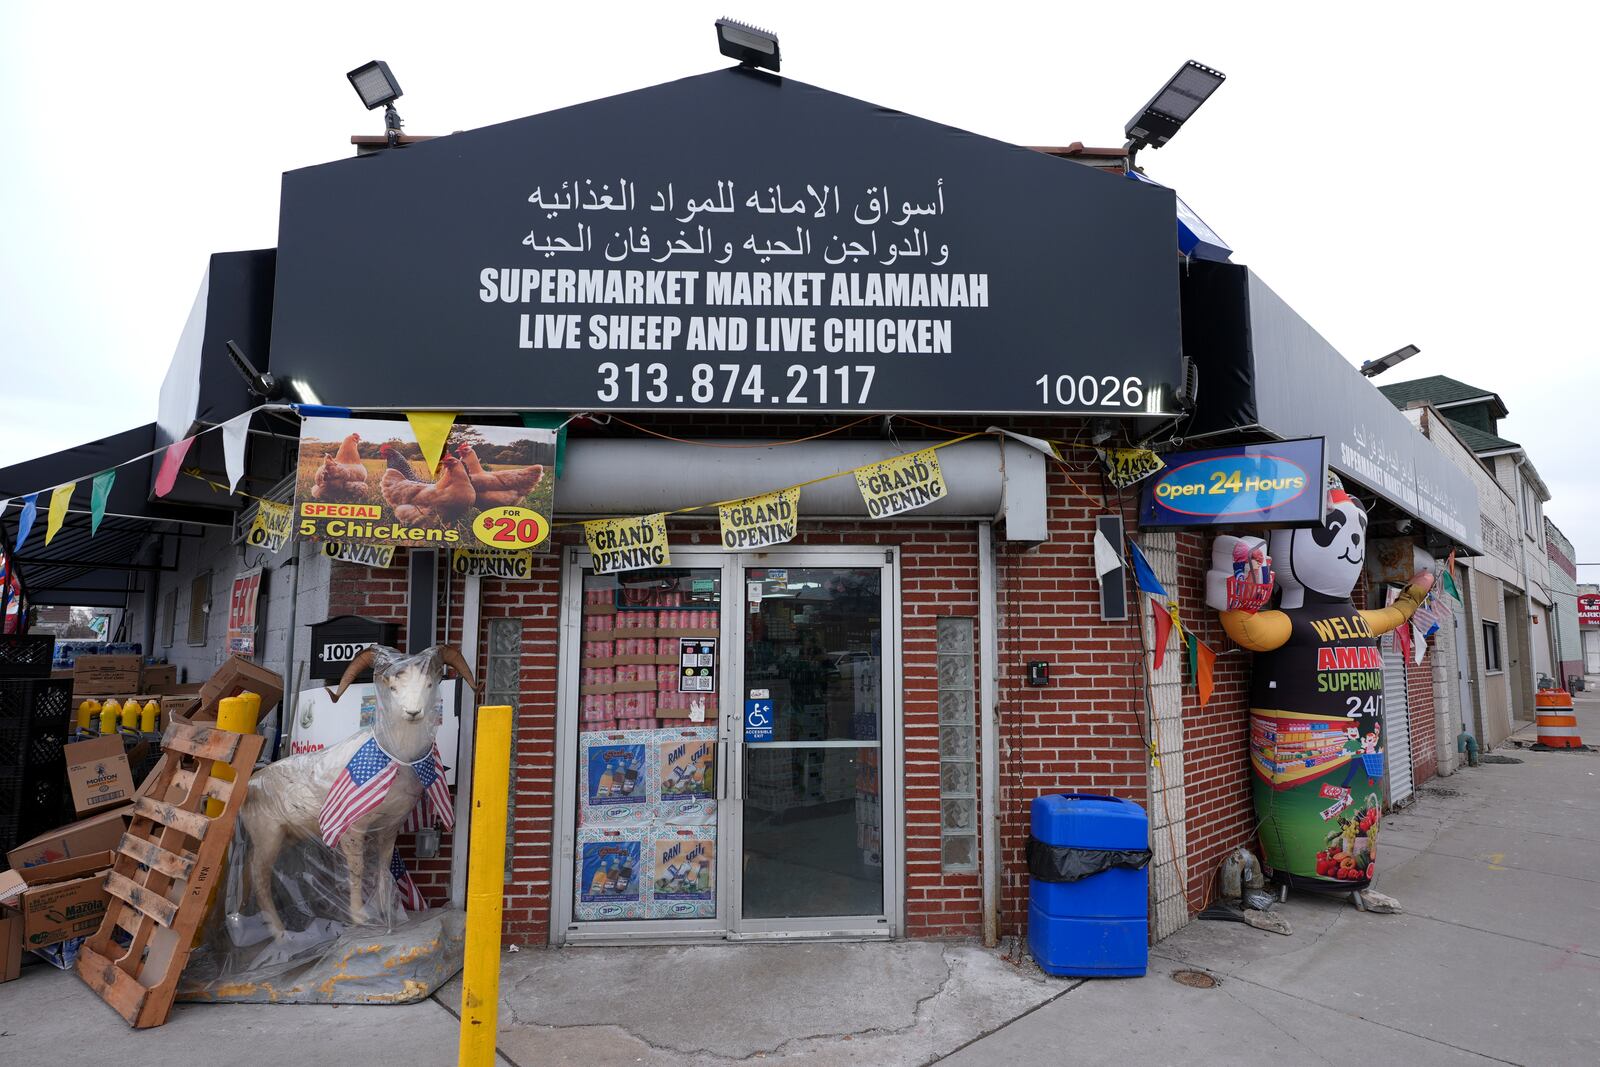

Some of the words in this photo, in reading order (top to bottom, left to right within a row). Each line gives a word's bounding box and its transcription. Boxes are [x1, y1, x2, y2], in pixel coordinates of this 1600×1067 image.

[528, 178, 635, 220] الغذائيه
[651, 179, 735, 223] للمواد
[746, 183, 840, 218] الامانه
[854, 178, 943, 224] أسواق
[522, 223, 592, 258] الحيه
[743, 226, 811, 264] الحيه
[479, 267, 699, 306] SUPERMARKET
[706, 271, 825, 306] MARKET
[830, 273, 989, 308] ALAMANAH
[518, 314, 582, 350] LIVE
[588, 315, 682, 351] SHEEP
[686, 317, 748, 352] AND
[755, 317, 817, 353] LIVE
[823, 318, 952, 354] CHICKEN
[597, 362, 876, 405] 313.874.2117
[1036, 375, 1143, 407] 10026
[868, 461, 929, 496] GRAND
[1156, 483, 1205, 499] Open
[1208, 470, 1243, 495] 24
[1245, 476, 1304, 492] Hours
[304, 504, 378, 518] SPECIAL
[503, 509, 521, 517] FOR
[730, 499, 792, 529] GRAND
[869, 480, 942, 518] OPENING
[300, 520, 316, 536] 5
[326, 520, 460, 542] Chickens
[483, 517, 540, 543] $20
[595, 524, 655, 551] GRAND
[724, 520, 796, 549] OPENING
[456, 556, 528, 577] OPENING
[592, 544, 665, 574] OPENING
[229, 575, 261, 630] EBT
[668, 743, 686, 765] RANI
[663, 842, 681, 864] RANI
